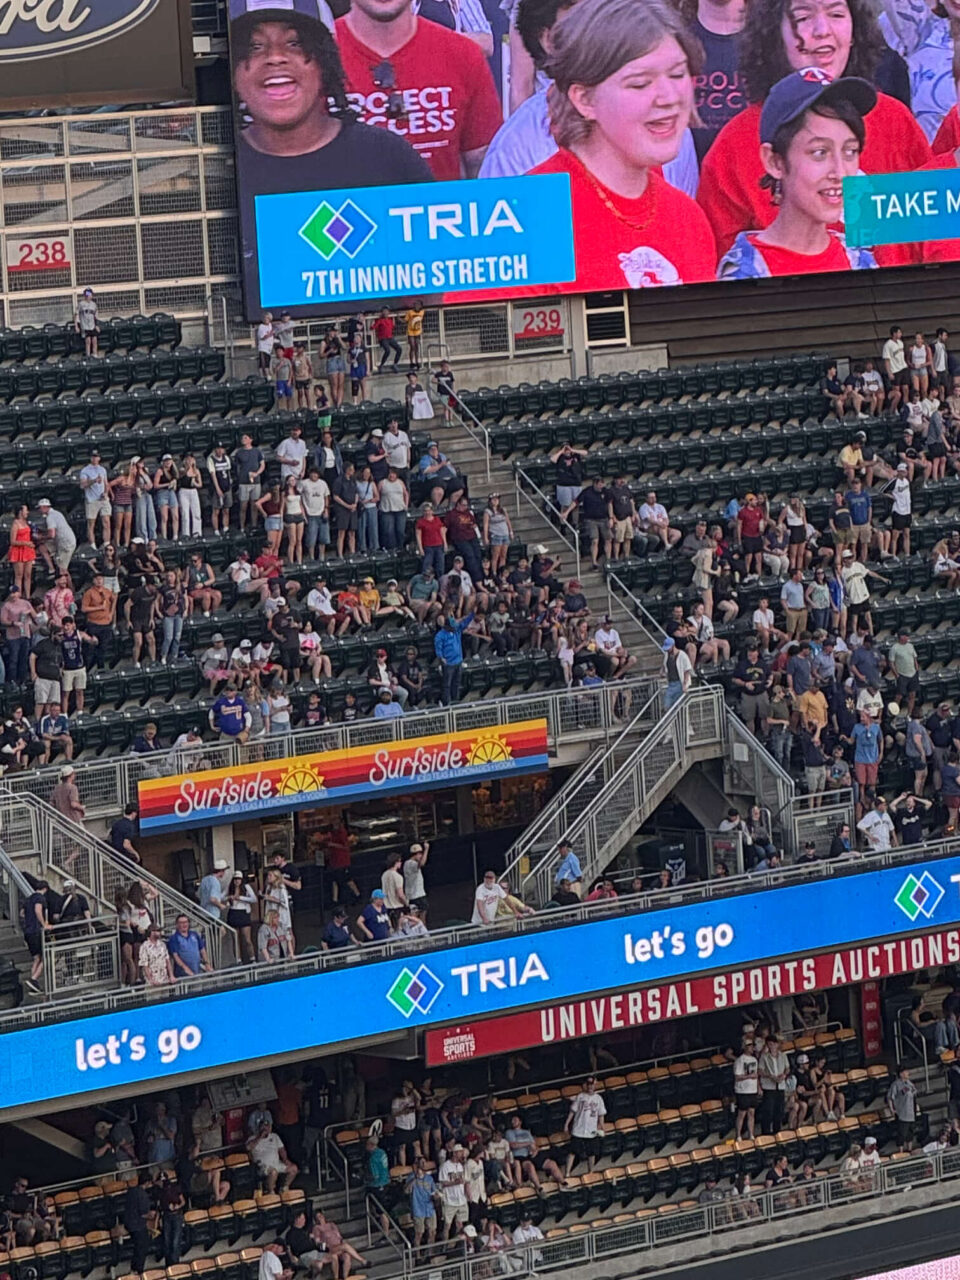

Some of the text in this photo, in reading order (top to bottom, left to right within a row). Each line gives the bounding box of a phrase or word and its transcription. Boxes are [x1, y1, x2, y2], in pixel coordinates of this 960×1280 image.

[327, 86, 453, 115] ROECT
[388, 199, 525, 243] TRIA
[871, 190, 938, 219] TAKE
[18, 240, 66, 266] 238
[301, 253, 529, 298] 7TH INNING STRETCH
[522, 308, 561, 332] 239
[369, 742, 463, 786] Surfside
[174, 771, 272, 818] Surfside
[624, 922, 734, 965] let's go
[450, 952, 550, 997] TRIA
[540, 930, 960, 1043] UNIVERSAL SPORTS AUCTIONS
[75, 1024, 202, 1071] let's go
[443, 1032, 475, 1045] UNIVERSAL
[443, 1041, 476, 1057] SPORTS
